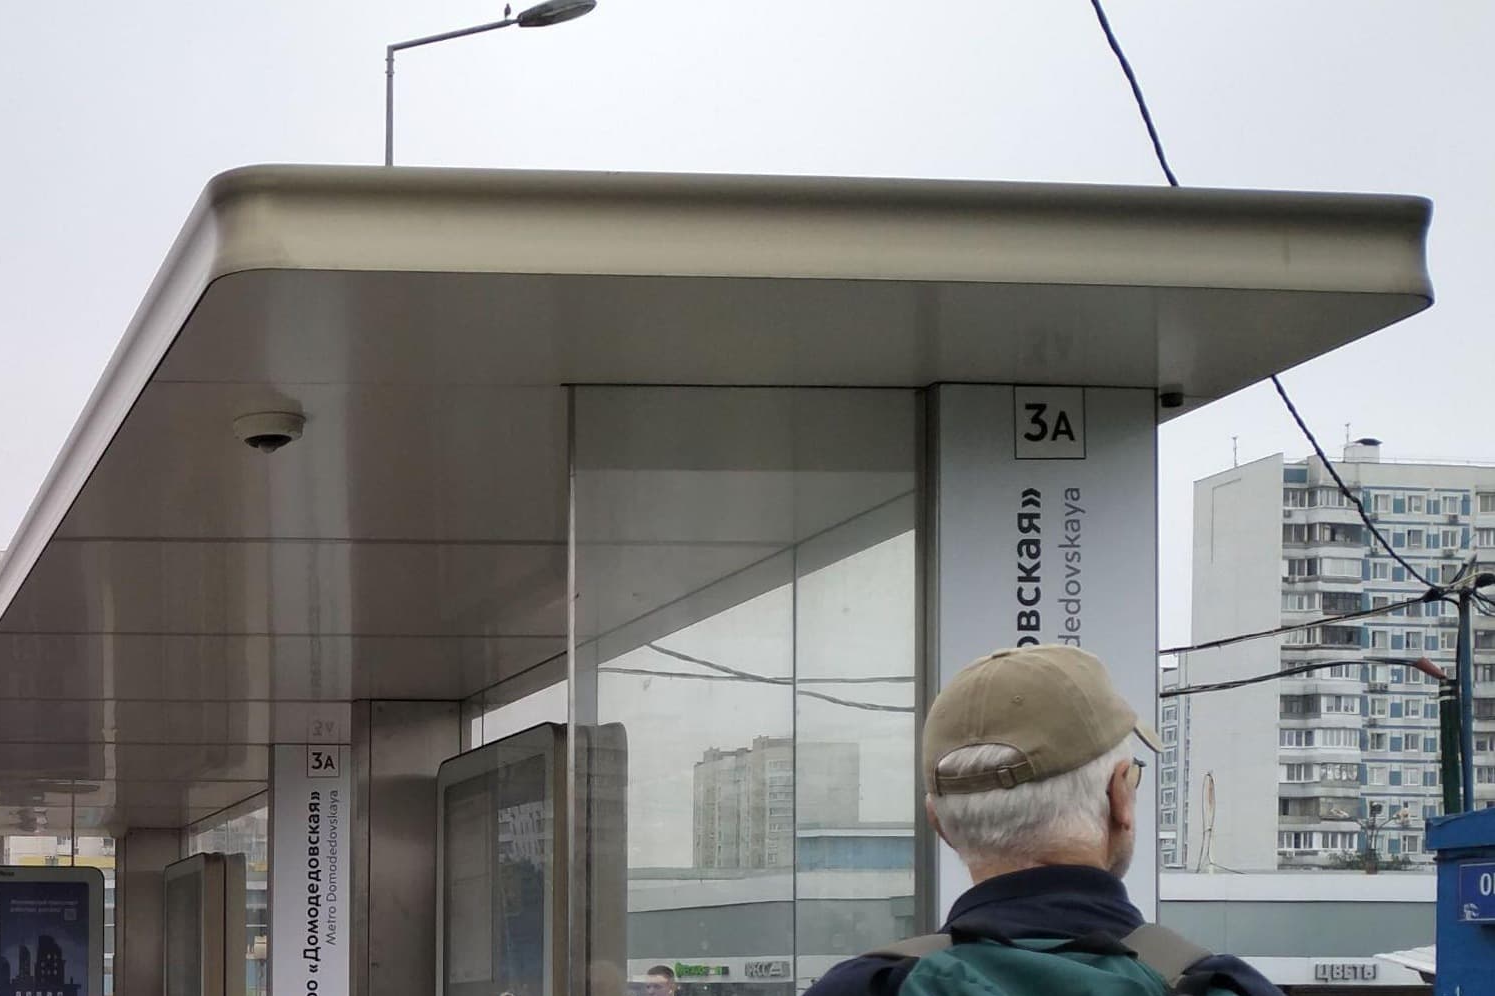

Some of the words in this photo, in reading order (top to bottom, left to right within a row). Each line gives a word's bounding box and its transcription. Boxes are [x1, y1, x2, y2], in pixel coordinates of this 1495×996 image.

[1024, 403, 1076, 442] 3А
[311, 751, 336, 770] 3А
[325, 790, 341, 903] Domodedovskaya
[302, 790, 322, 974] «Домодедовская»
[325, 905, 337, 946] Metro
[1314, 963, 1377, 983] ЦВЕТЫ
